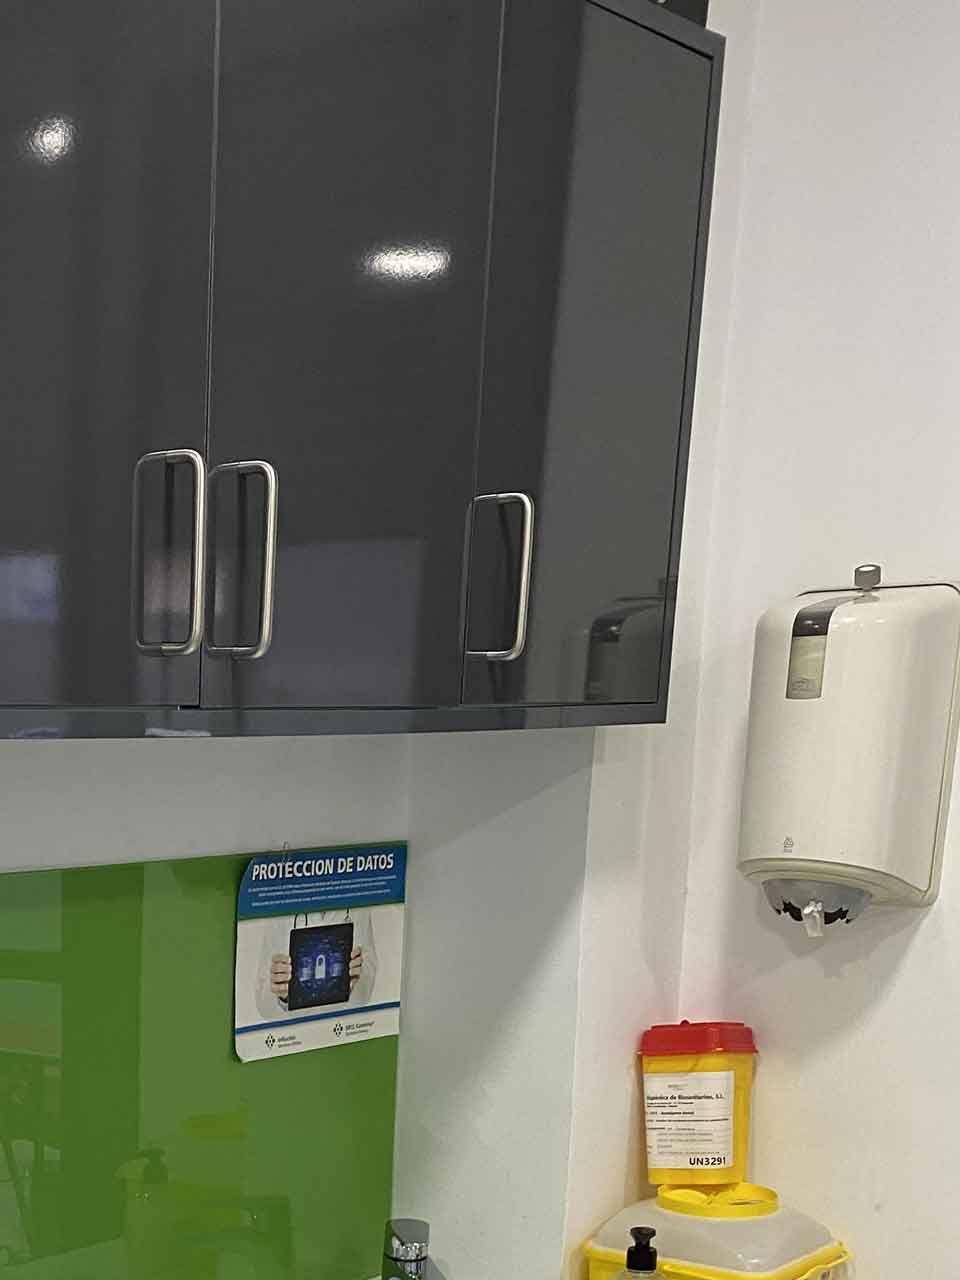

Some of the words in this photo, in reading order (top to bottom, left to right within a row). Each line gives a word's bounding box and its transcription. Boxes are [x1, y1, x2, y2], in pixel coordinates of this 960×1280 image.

[252, 859, 334, 881] PROTECCION
[337, 857, 354, 873] DE
[356, 853, 395, 872] DATOS
[689, 1156, 726, 1166] UN3291
